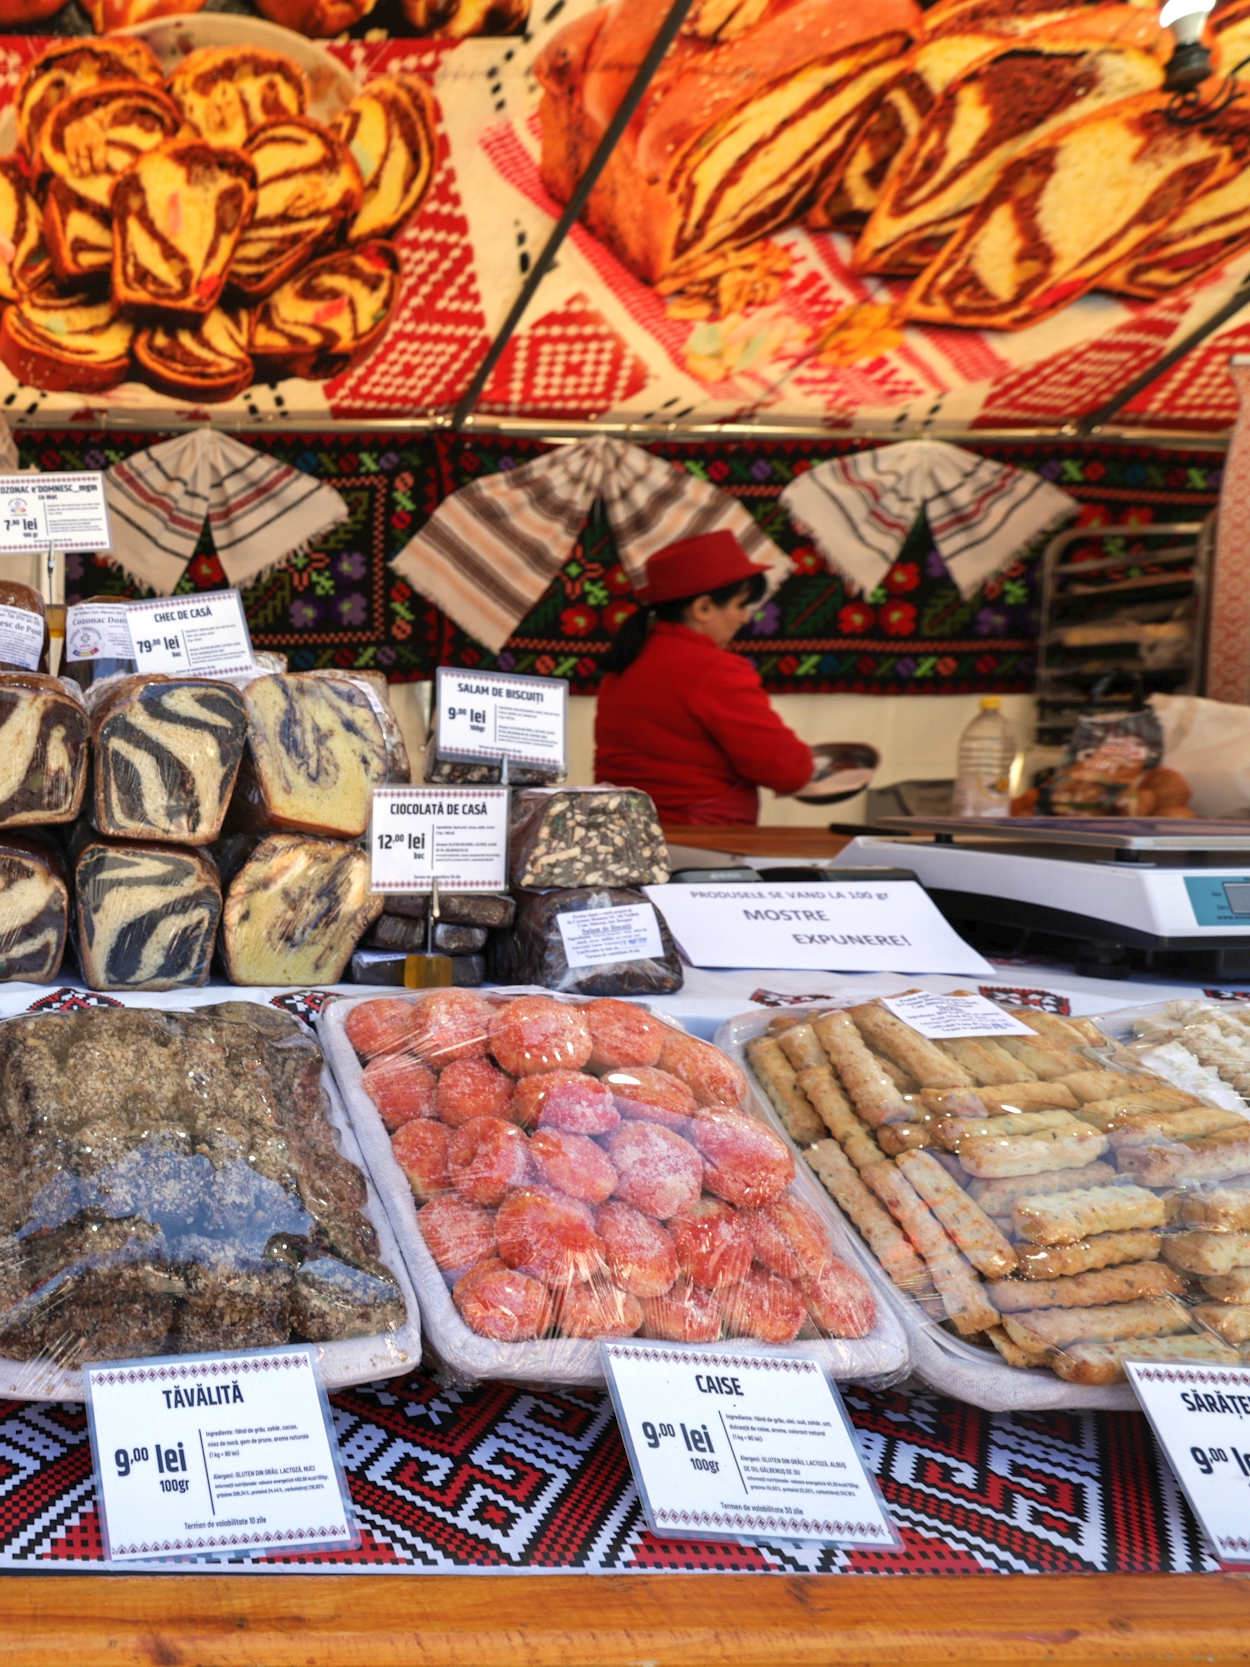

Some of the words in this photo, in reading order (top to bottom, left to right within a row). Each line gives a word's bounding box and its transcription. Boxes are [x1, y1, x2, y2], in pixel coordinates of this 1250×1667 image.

[23, 518, 38, 530] lei
[73, 618, 105, 626] Cozonac
[154, 612, 176, 622] CHEC
[177, 610, 189, 620] DE
[15, 622, 24, 631] de
[26, 625, 41, 637] Post
[164, 636, 179, 650] lei
[458, 683, 489, 695] SALAM
[492, 687, 503, 697] DE
[506, 689, 544, 704] BISCUIȚI
[448, 707, 466, 719] 9,00
[470, 709, 486, 723] lei
[391, 802, 444, 815] CIOCOLATĂ
[447, 804, 459, 815] DE
[462, 802, 487, 815] CASĂ
[378, 834, 404, 849] 12,00
[408, 833, 425, 849] lei
[690, 891, 767, 899] PRODUSELE
[768, 891, 784, 899] SE
[785, 891, 826, 899] VAND
[830, 891, 846, 899] LA
[850, 891, 873, 899] 100
[875, 893, 889, 901] gr
[743, 909, 830, 921] MOSTRE
[792, 933, 911, 947] EXPUNERE!
[694, 1374, 744, 1396] CAISE
[163, 1380, 244, 1409] TĂVĂLITĂ
[1181, 1389, 1250, 1420] SĂRĂȚE
[642, 1421, 676, 1449] 9,00
[680, 1423, 715, 1454] lei
[115, 1447, 149, 1477] 9,00
[155, 1442, 187, 1474] lei
[690, 1458, 720, 1474] 100gr
[1190, 1447, 1228, 1474] 9,00
[160, 1478, 189, 1493] 100gr
[720, 1502, 742, 1511] Termen
[752, 1505, 784, 1514] valabilitate
[793, 1507, 803, 1515] zile
[184, 1522, 206, 1530] Termen
[216, 1518, 248, 1527] valabilitate
